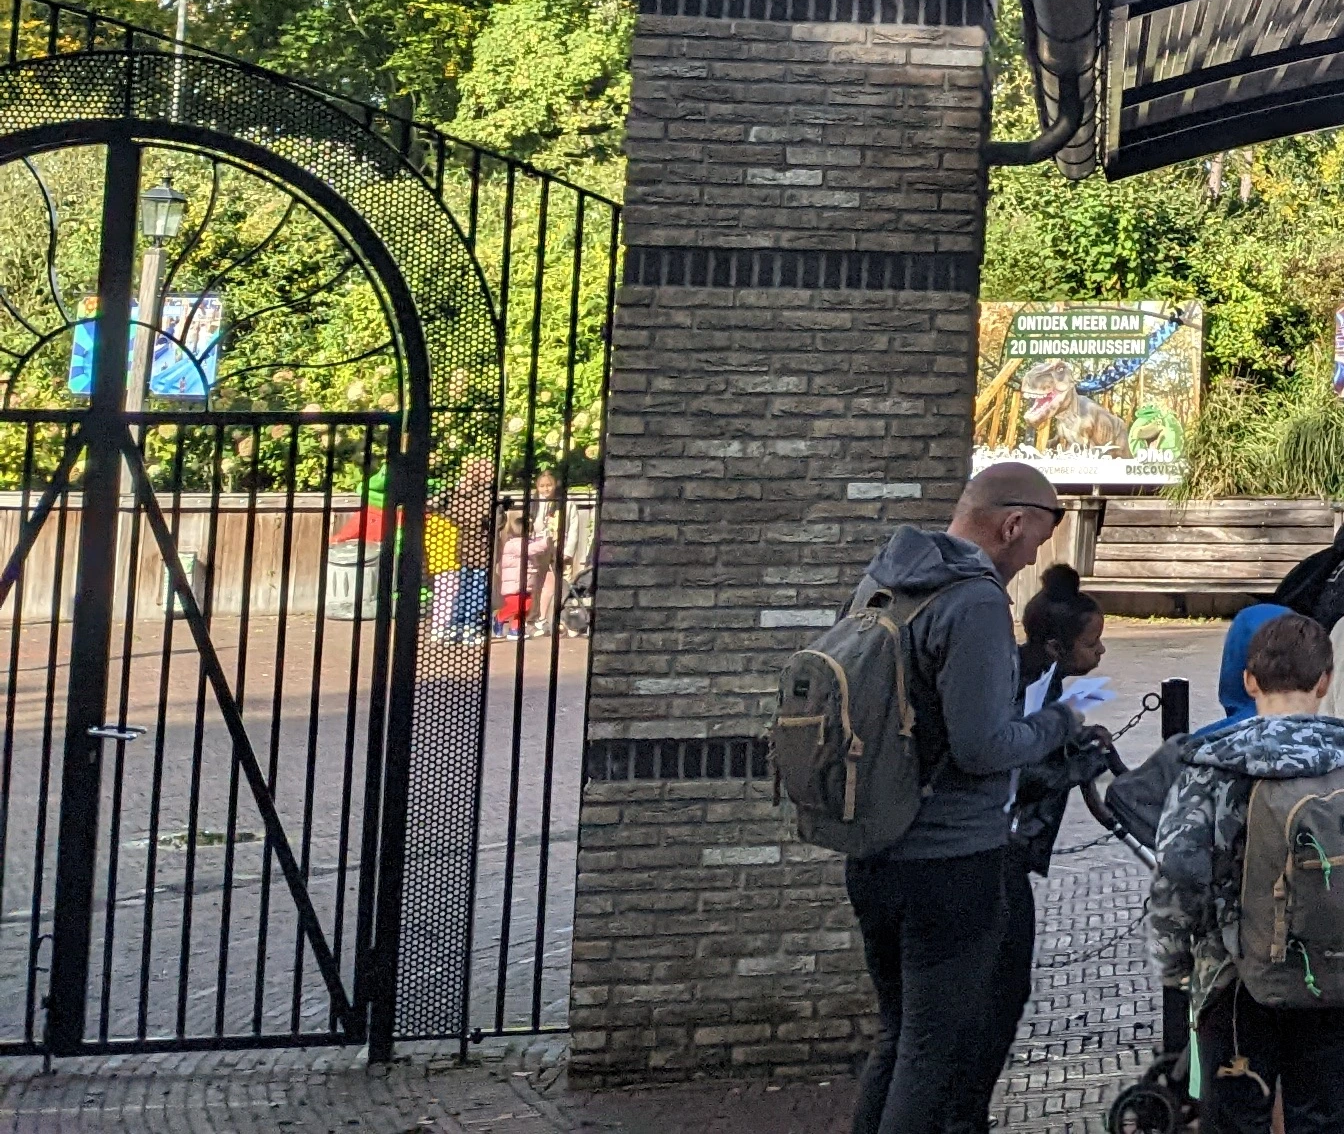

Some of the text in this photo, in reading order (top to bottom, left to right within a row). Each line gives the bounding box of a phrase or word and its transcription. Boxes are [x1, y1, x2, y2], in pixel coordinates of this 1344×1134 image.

[1017, 315, 1140, 331] ONTDEK MEER DAN
[1010, 339, 1146, 355] 20 DINOSAURUSSEN!
[1137, 449, 1174, 463] DINO
[1036, 466, 1099, 475] OVEMBER 2022
